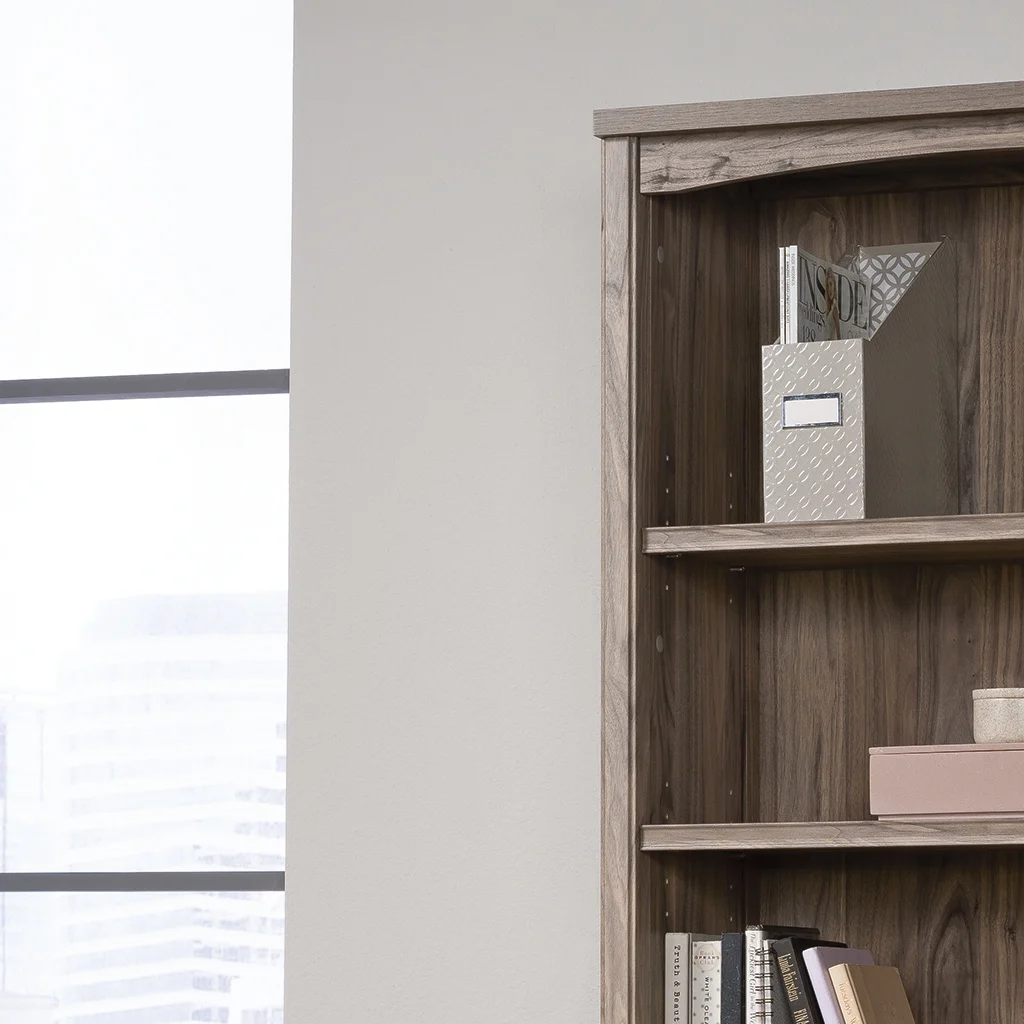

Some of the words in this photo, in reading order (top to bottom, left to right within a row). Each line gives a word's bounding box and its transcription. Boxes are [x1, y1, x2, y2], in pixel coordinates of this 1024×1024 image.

[673, 945, 681, 976] Truth
[778, 953, 794, 974] Linda
[782, 970, 802, 1002] Fairstein
